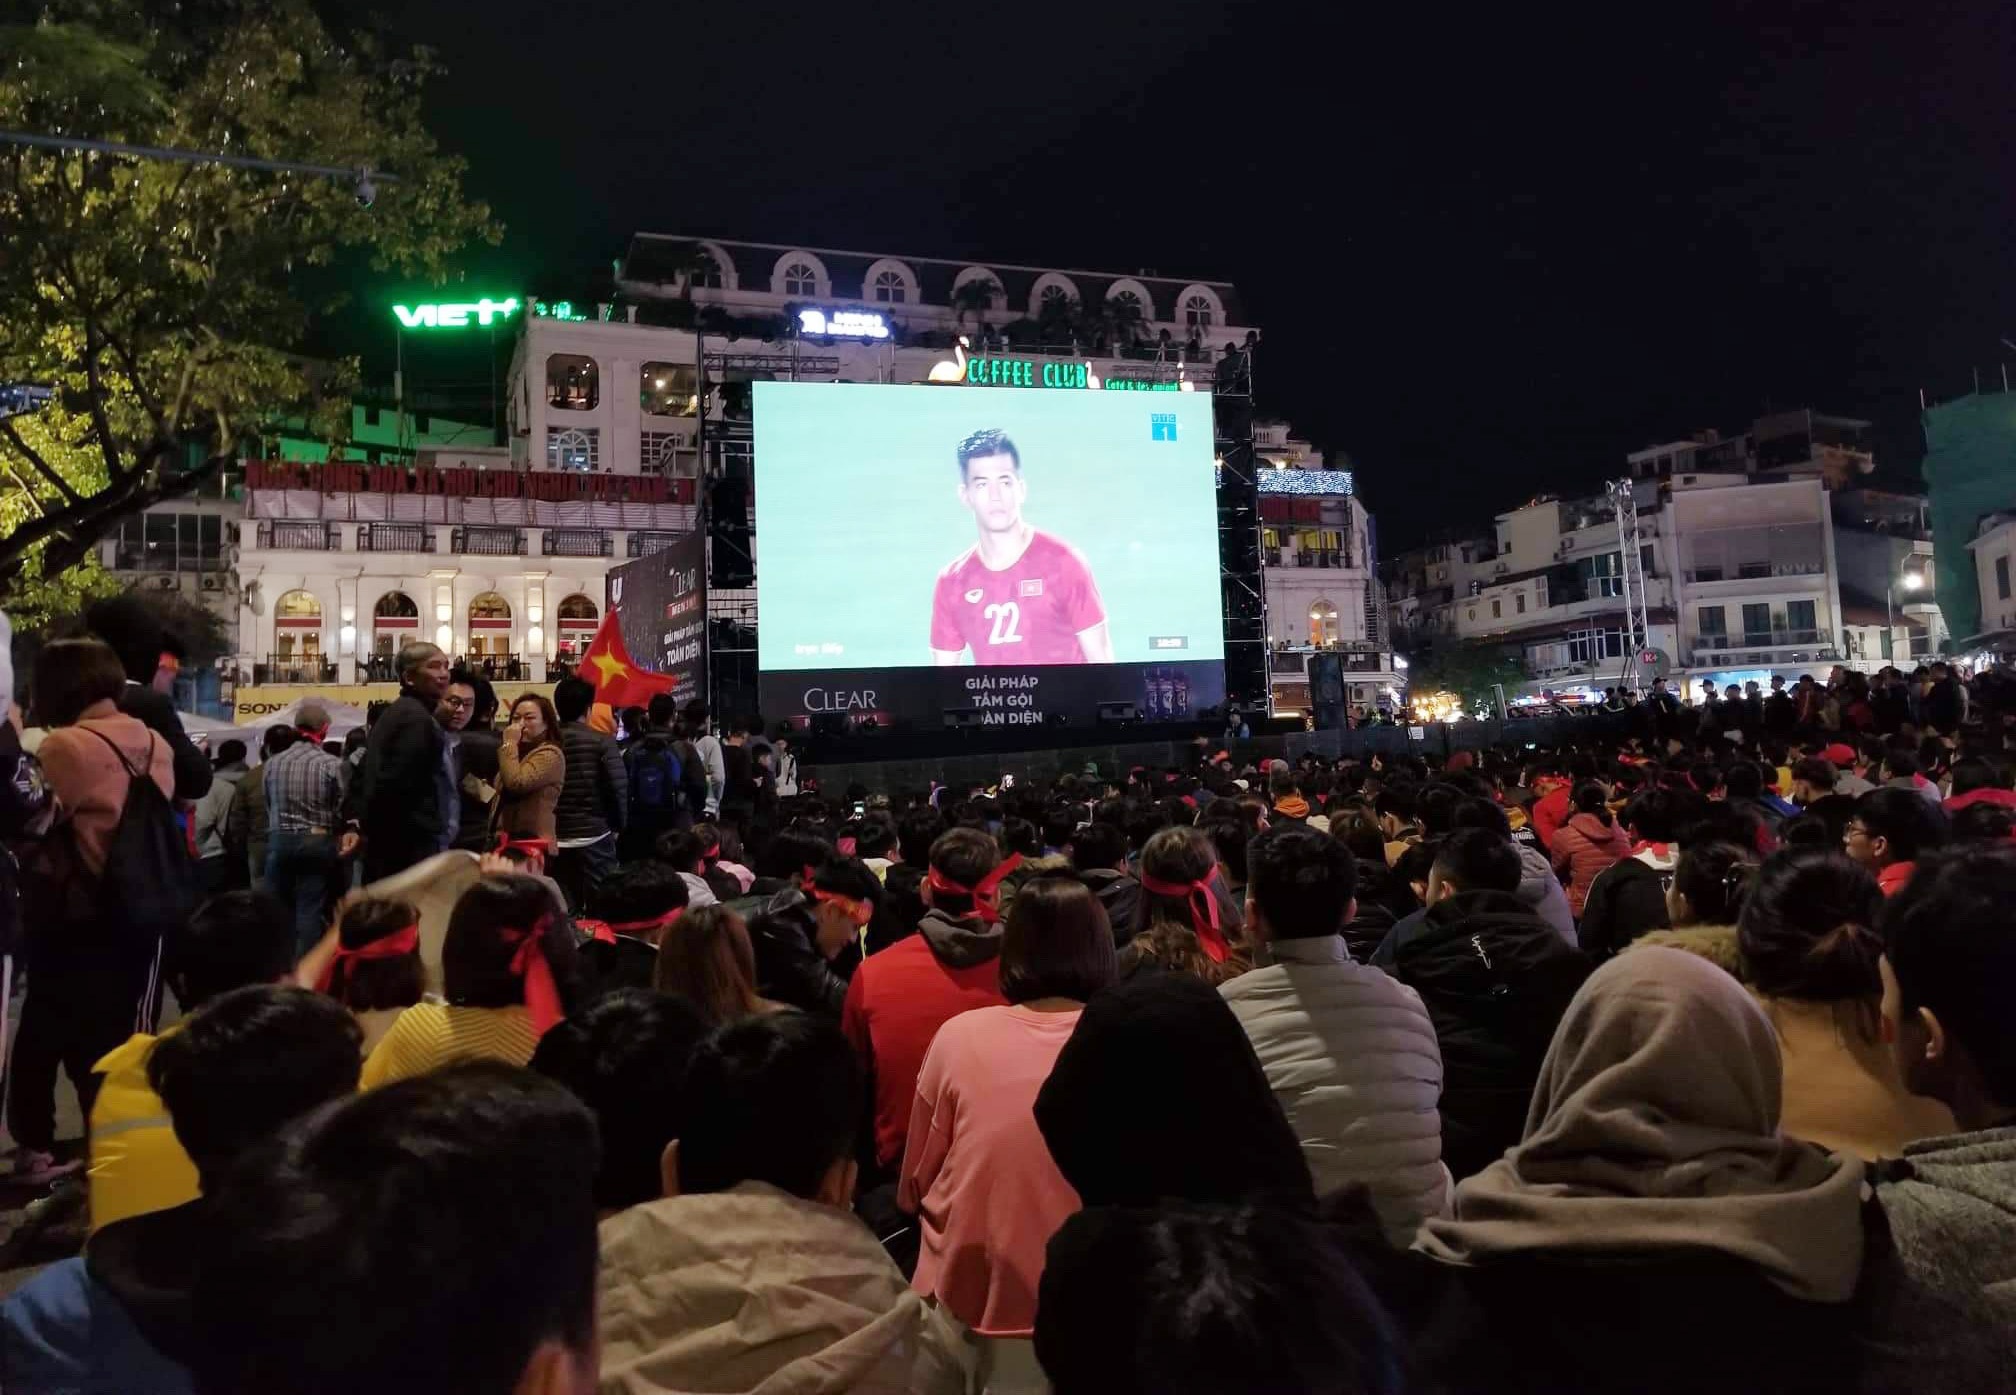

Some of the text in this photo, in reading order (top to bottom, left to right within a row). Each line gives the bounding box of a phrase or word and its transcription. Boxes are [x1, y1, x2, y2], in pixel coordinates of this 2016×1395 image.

[967, 358, 1086, 388] COFFEE CLUB
[1160, 426, 1169, 442] 1
[984, 601, 1024, 645] 22
[965, 674, 1039, 690] GIẢI PHÁP
[803, 688, 877, 712] CLEAR
[972, 690, 1033, 708] TẮM GỘI
[238, 703, 289, 715] SON
[1008, 709, 1043, 726] DIỆN
